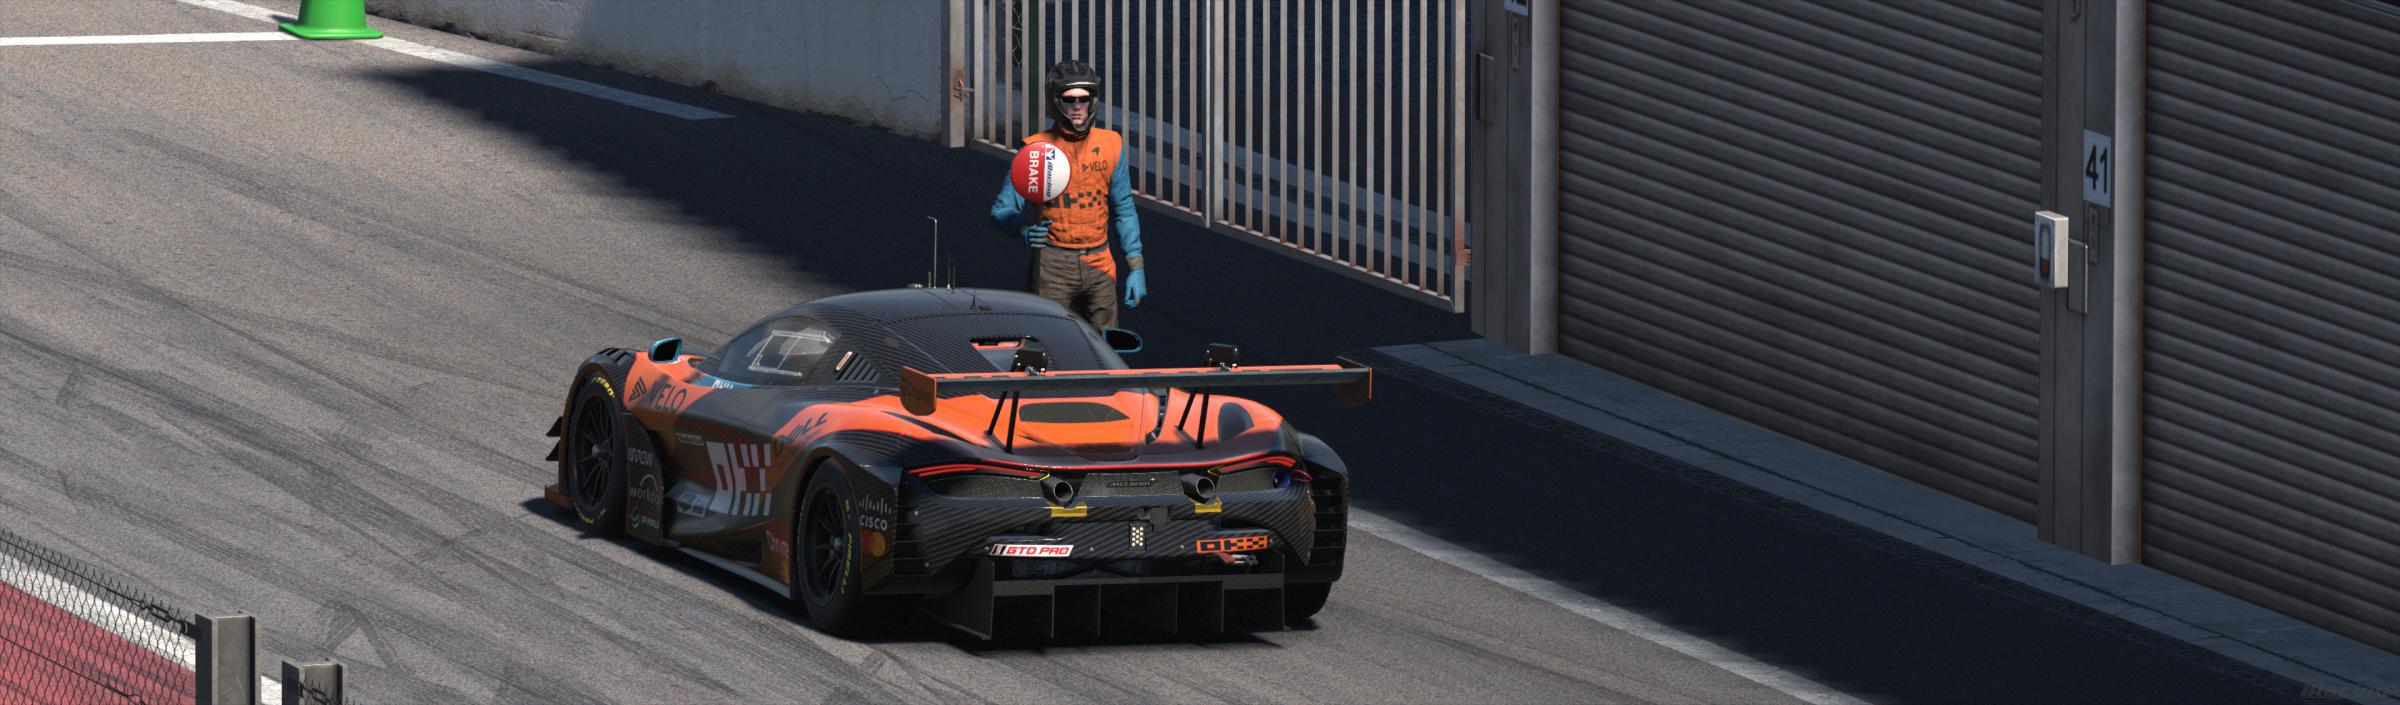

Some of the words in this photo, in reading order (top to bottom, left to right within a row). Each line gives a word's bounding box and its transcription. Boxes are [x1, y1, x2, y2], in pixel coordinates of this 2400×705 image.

[1028, 150, 1040, 194] BRAKE
[1090, 159, 1108, 172] VELO
[2085, 144, 2108, 194] 41
[860, 514, 888, 531] CISCO
[1006, 546, 1038, 556] GTD
[1039, 546, 1071, 556] PRO
